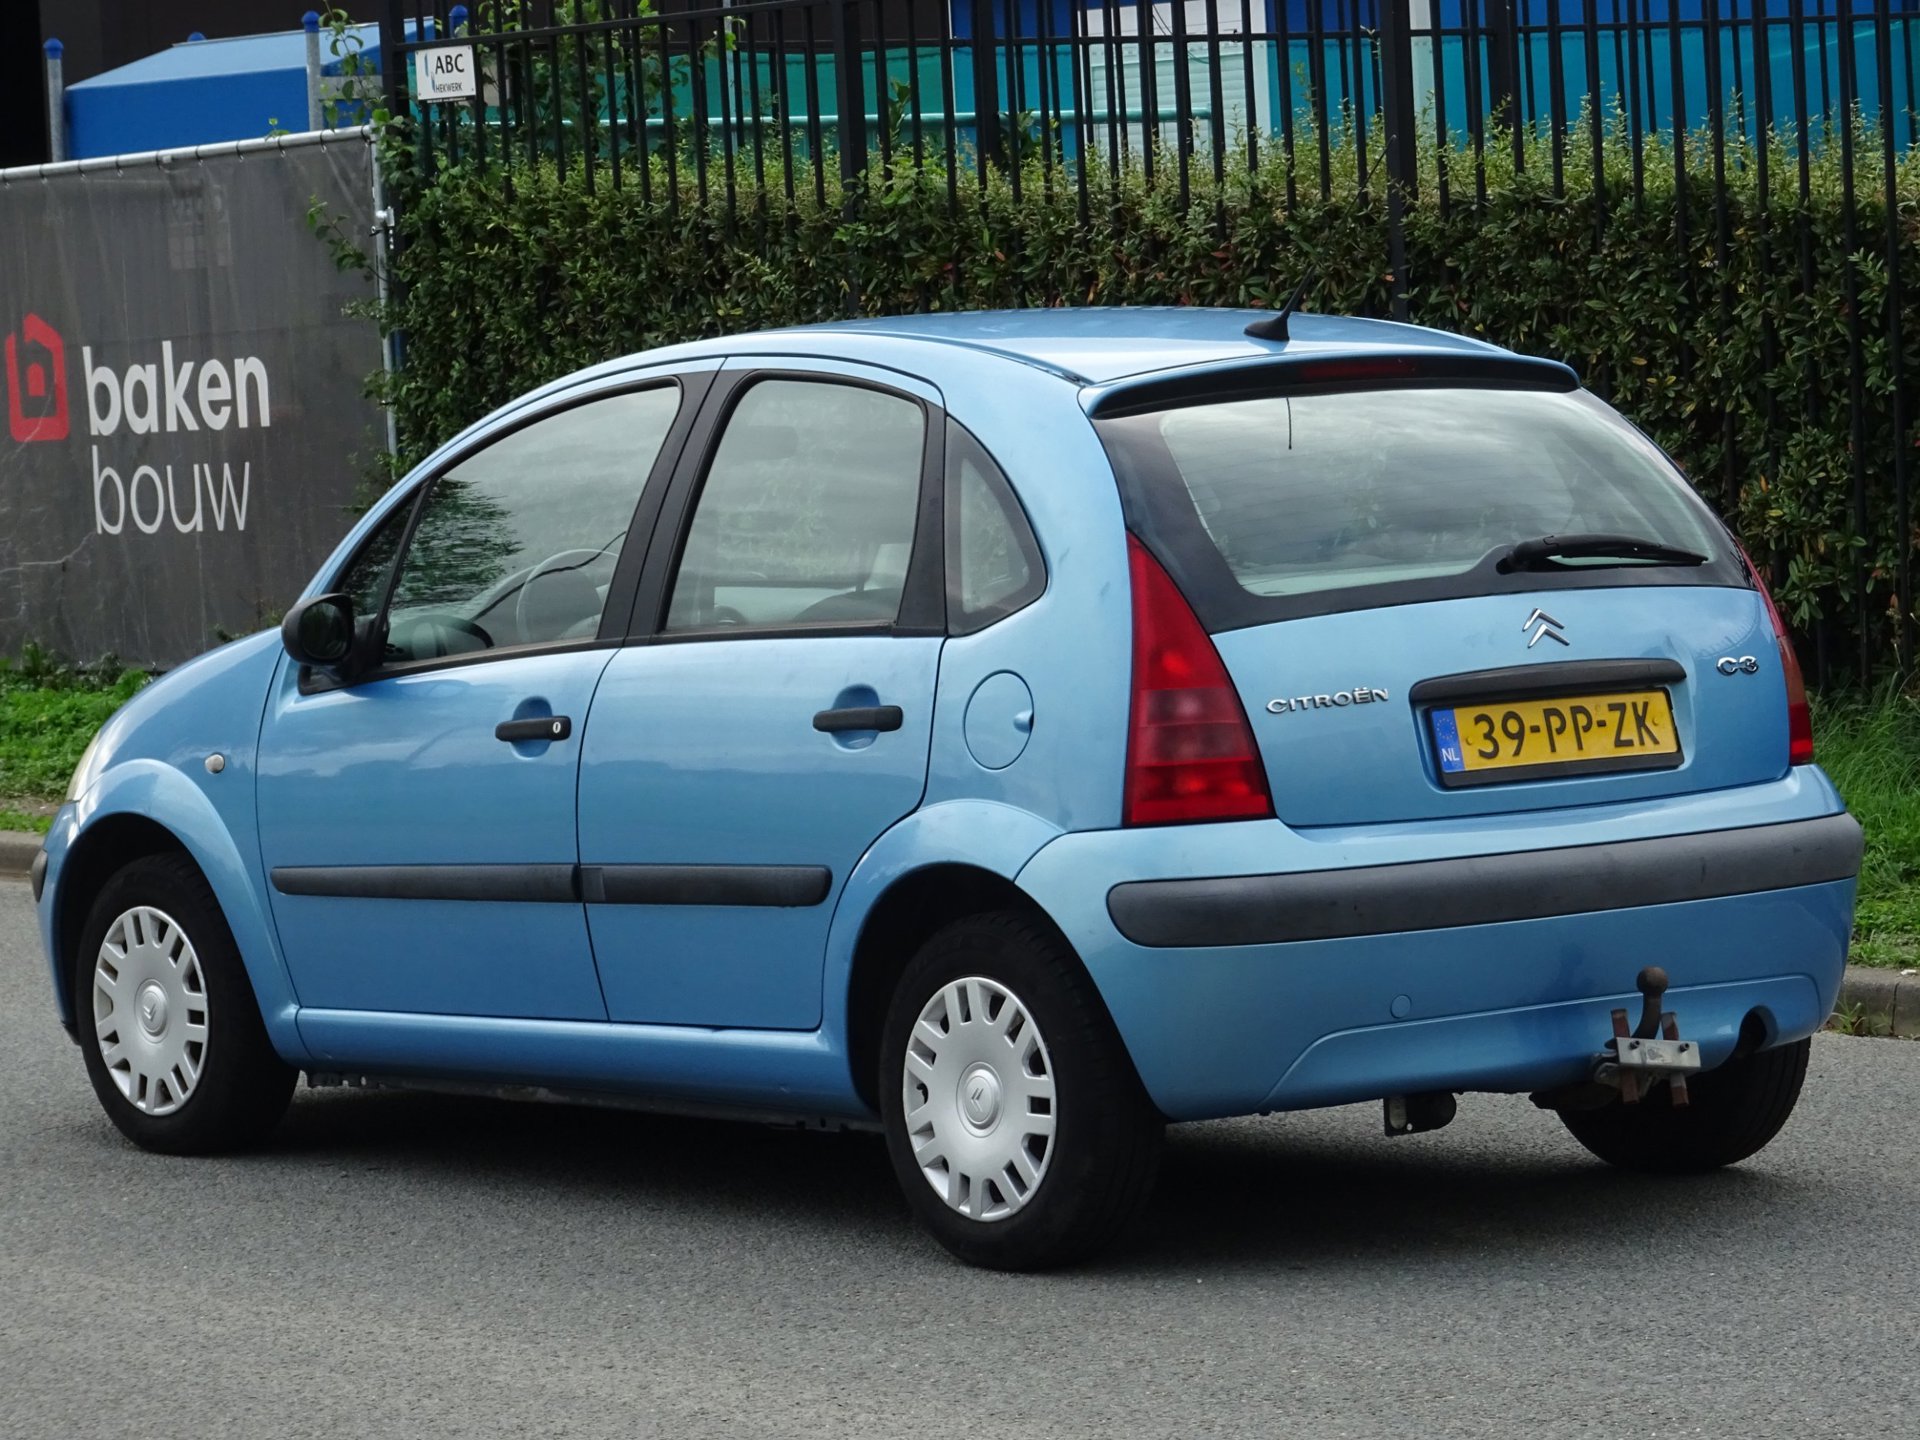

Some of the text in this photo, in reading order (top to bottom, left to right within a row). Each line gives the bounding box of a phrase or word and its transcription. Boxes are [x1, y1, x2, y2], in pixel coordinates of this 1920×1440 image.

[435, 53, 465, 75] ABC
[435, 82, 463, 93] HEKWERK
[82, 340, 271, 436] baken
[91, 445, 250, 535] bouw
[1716, 655, 1759, 677] C3
[1265, 687, 1389, 714] CITROËN
[1473, 701, 1660, 760] 39-PP-ZK
[1441, 747, 1460, 762] NL
